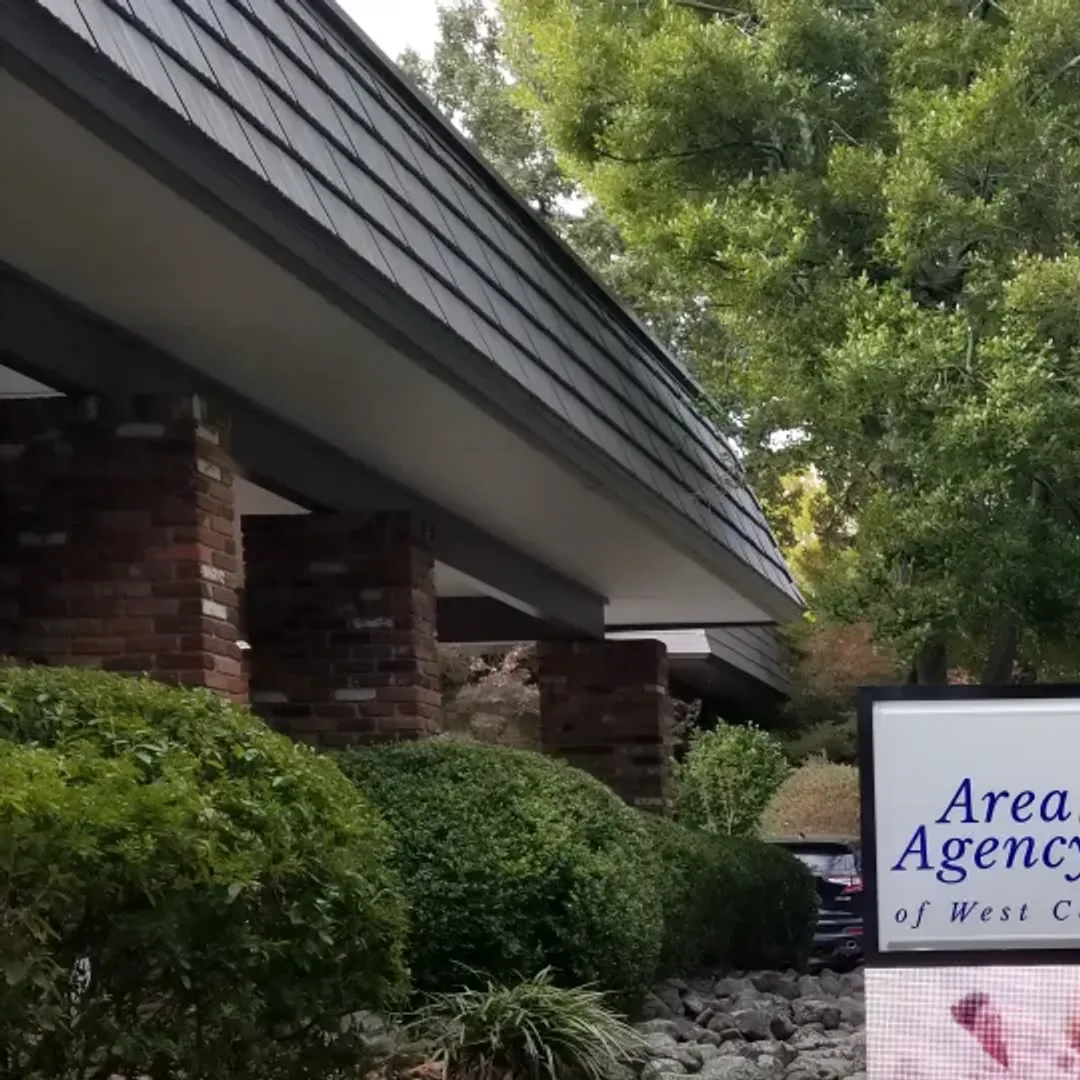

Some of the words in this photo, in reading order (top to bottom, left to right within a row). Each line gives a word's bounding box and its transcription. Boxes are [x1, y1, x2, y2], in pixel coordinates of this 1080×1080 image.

[935, 777, 1072, 824] Area
[894, 900, 932, 930] of
[950, 901, 1029, 924] West
